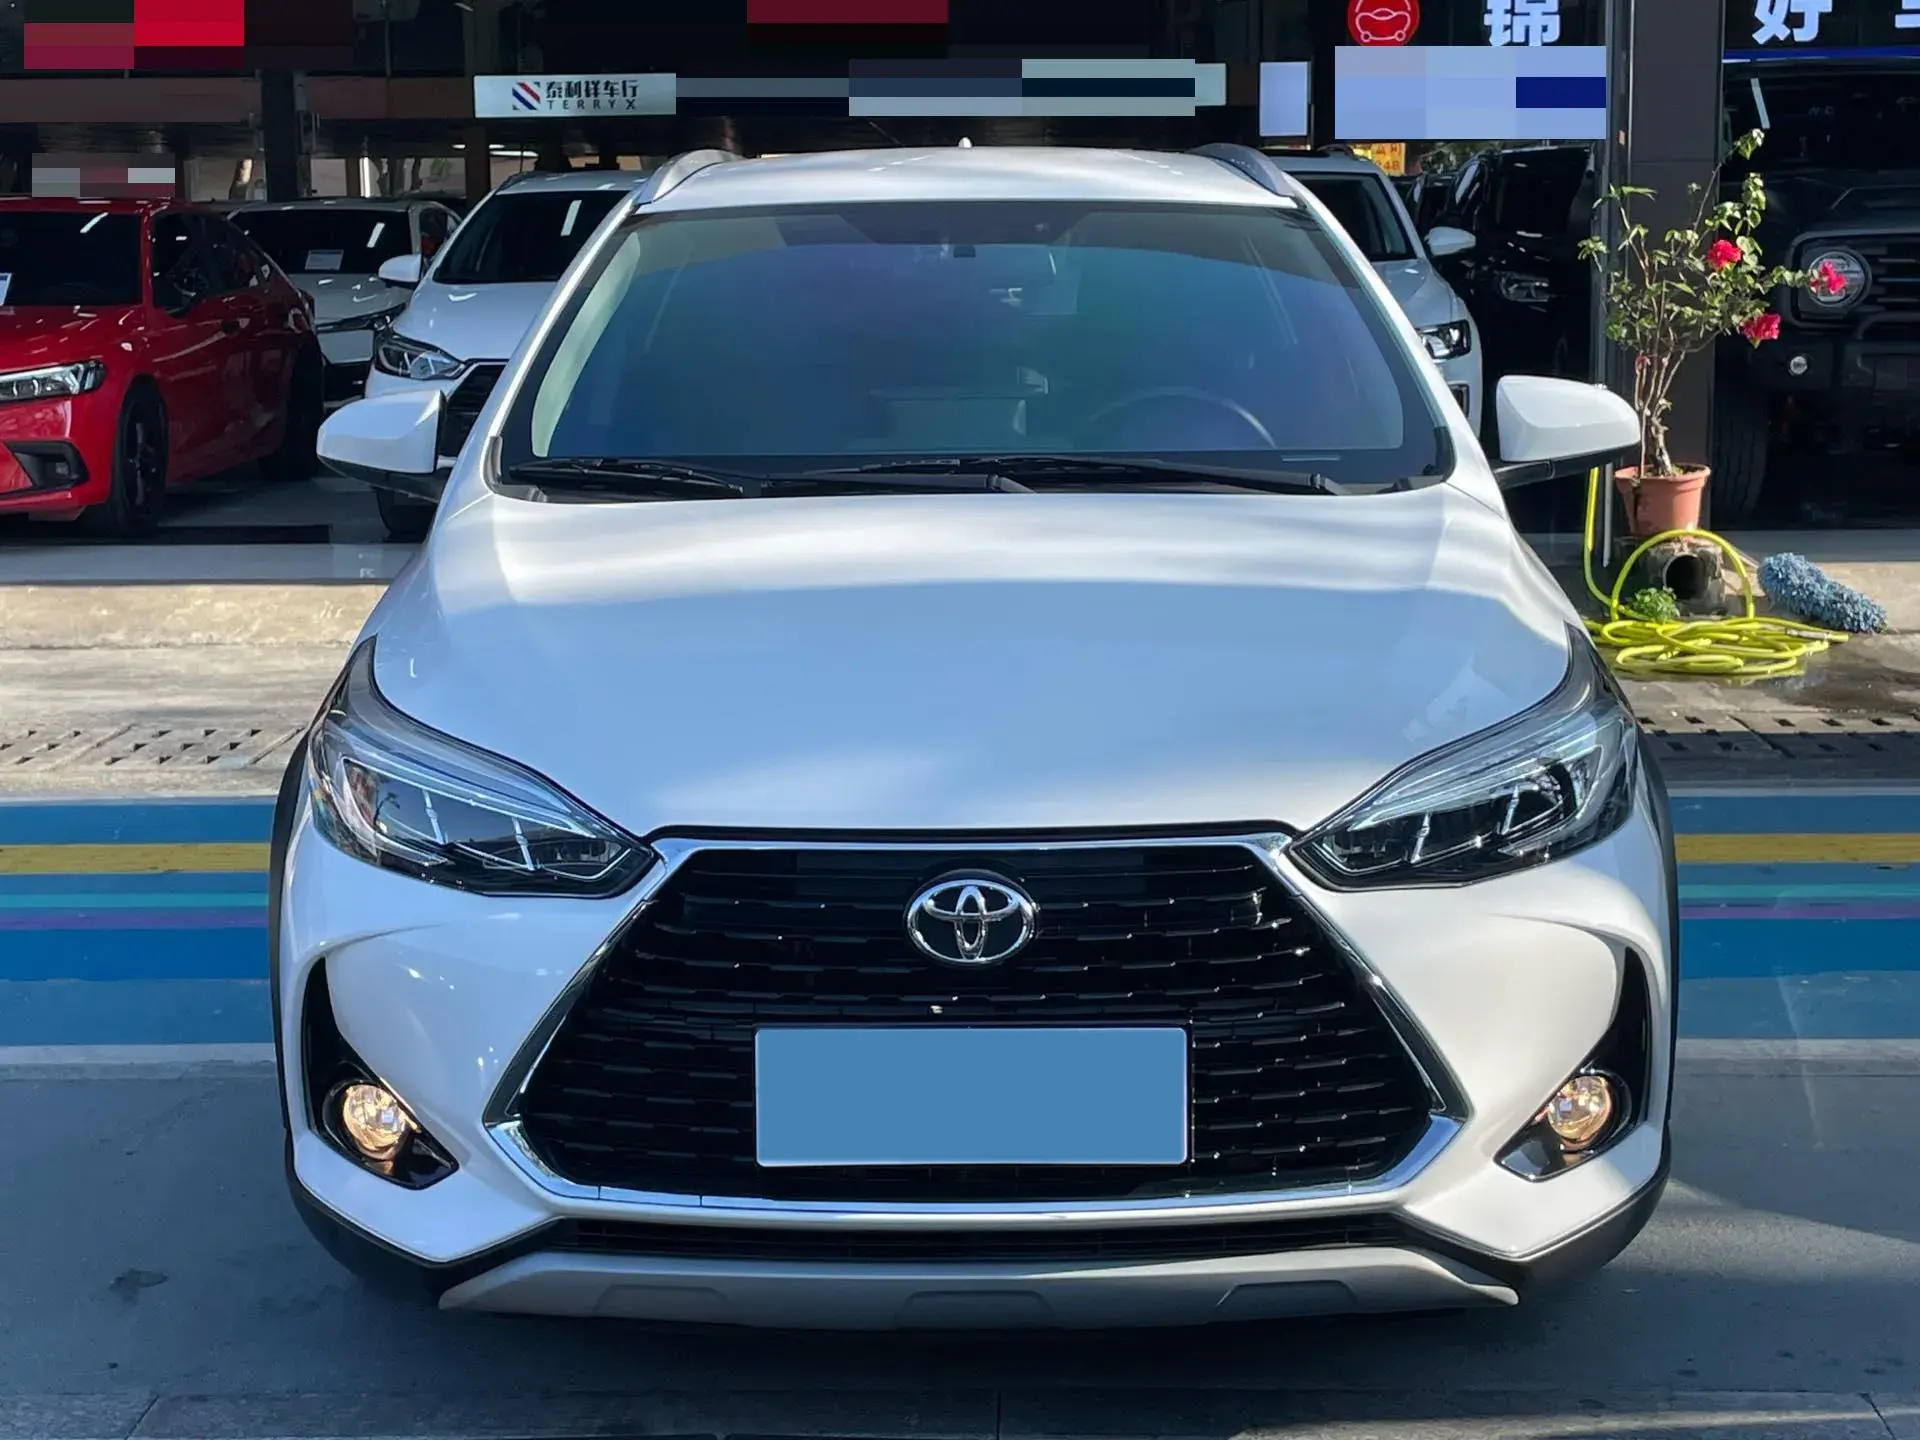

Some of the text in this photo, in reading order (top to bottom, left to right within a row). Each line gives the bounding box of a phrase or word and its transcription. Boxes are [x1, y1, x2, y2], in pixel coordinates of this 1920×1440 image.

[546, 79, 640, 99] 泰利祥车行
